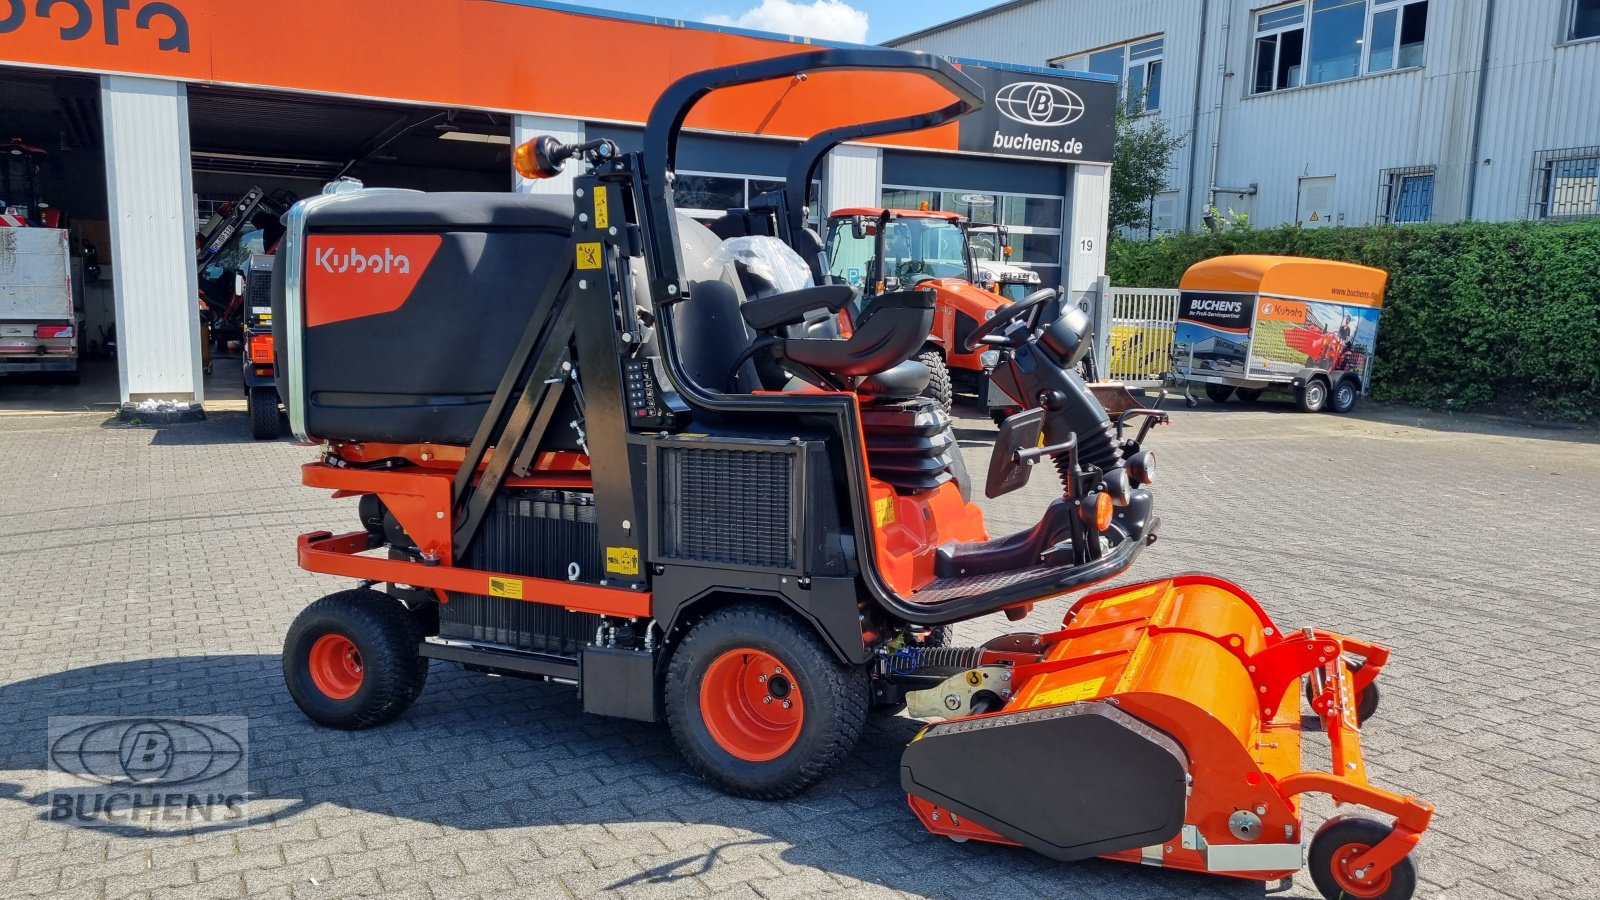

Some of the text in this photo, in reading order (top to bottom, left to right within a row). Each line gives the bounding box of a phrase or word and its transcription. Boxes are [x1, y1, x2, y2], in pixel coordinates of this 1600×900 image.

[993, 131, 1083, 155] buchens.de
[1081, 240, 1093, 251] 19
[315, 247, 410, 274] Kubota
[1331, 287, 1378, 300] www.buchens.de
[1190, 299, 1242, 313] BUCHEN'S
[1274, 305, 1303, 317] Kubota
[1196, 310, 1240, 319] Profi-Servicepartner
